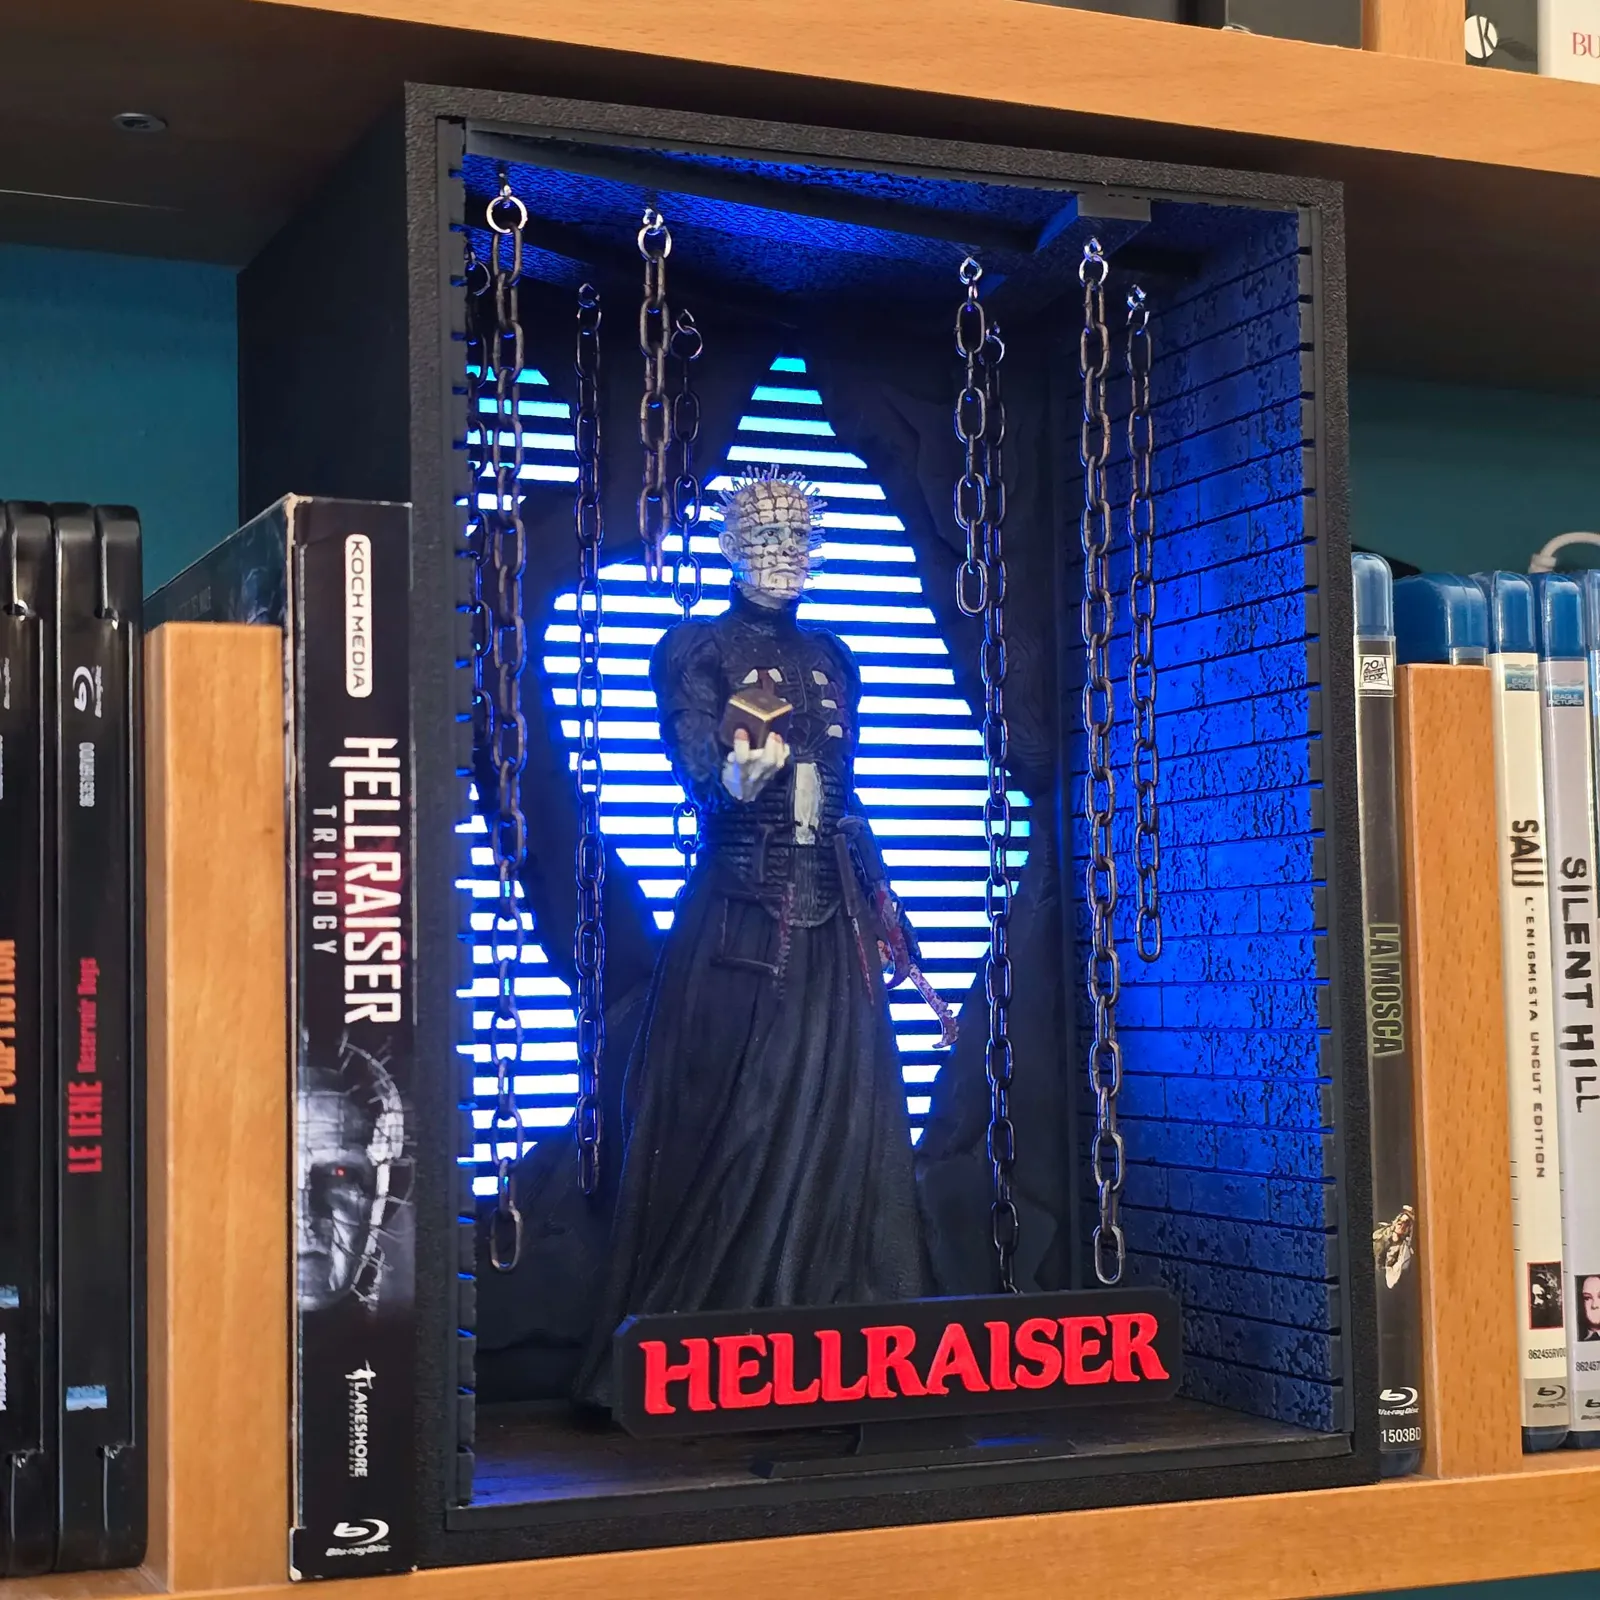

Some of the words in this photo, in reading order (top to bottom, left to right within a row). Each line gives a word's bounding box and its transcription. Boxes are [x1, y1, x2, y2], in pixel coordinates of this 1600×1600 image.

[351, 541, 365, 608] KOCH
[352, 616, 366, 690] MEDIA
[312, 805, 338, 954] TRILOGY
[329, 737, 402, 1025] HELLRAISER
[1509, 820, 1544, 887] SAW
[1369, 925, 1400, 957] LA
[1524, 896, 1539, 1021] L'ENIGMISTA
[1558, 857, 1593, 1009] SILENT
[1371, 963, 1403, 1055] MOSCA
[1530, 1032, 1542, 1094] UNCUT
[1559, 1024, 1600, 1113] HILL
[67, 1080, 103, 1137] IENE
[1533, 1102, 1545, 1178] EDITION
[67, 1146, 103, 1173] LE
[638, 1312, 1170, 1415] HELLRAISER
[354, 1381, 368, 1478] LAKESHORE
[1380, 1427, 1422, 1443] 1503BD
